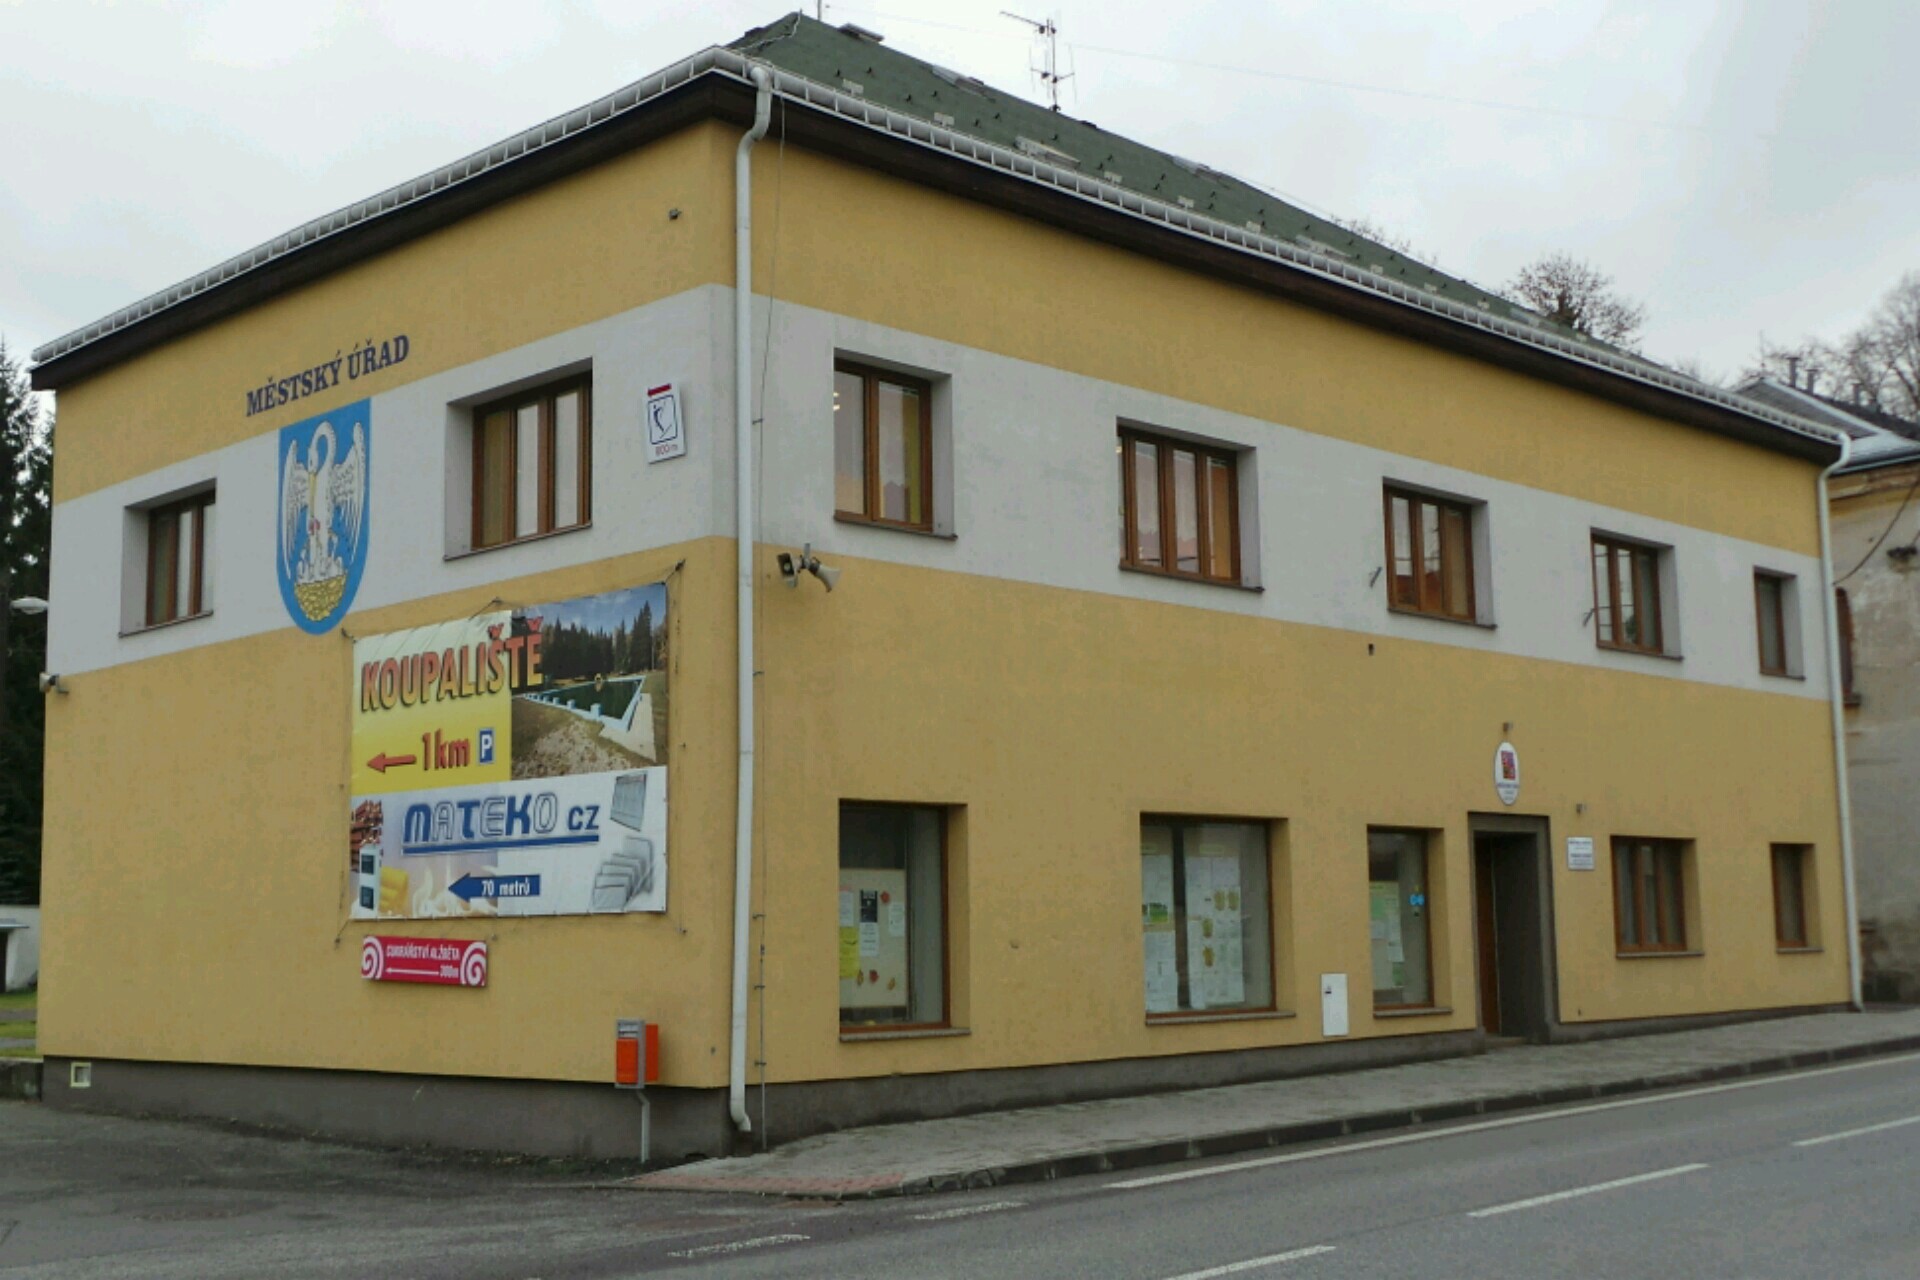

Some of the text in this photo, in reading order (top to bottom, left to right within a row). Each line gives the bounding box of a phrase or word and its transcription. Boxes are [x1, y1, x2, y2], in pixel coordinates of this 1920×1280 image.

[246, 335, 409, 417] MĚSTSKÝ ÚŘAD
[361, 616, 544, 713] KOUPALIŠTĚ
[403, 792, 558, 843] MATEKO
[481, 877, 530, 896] 70 metrů
